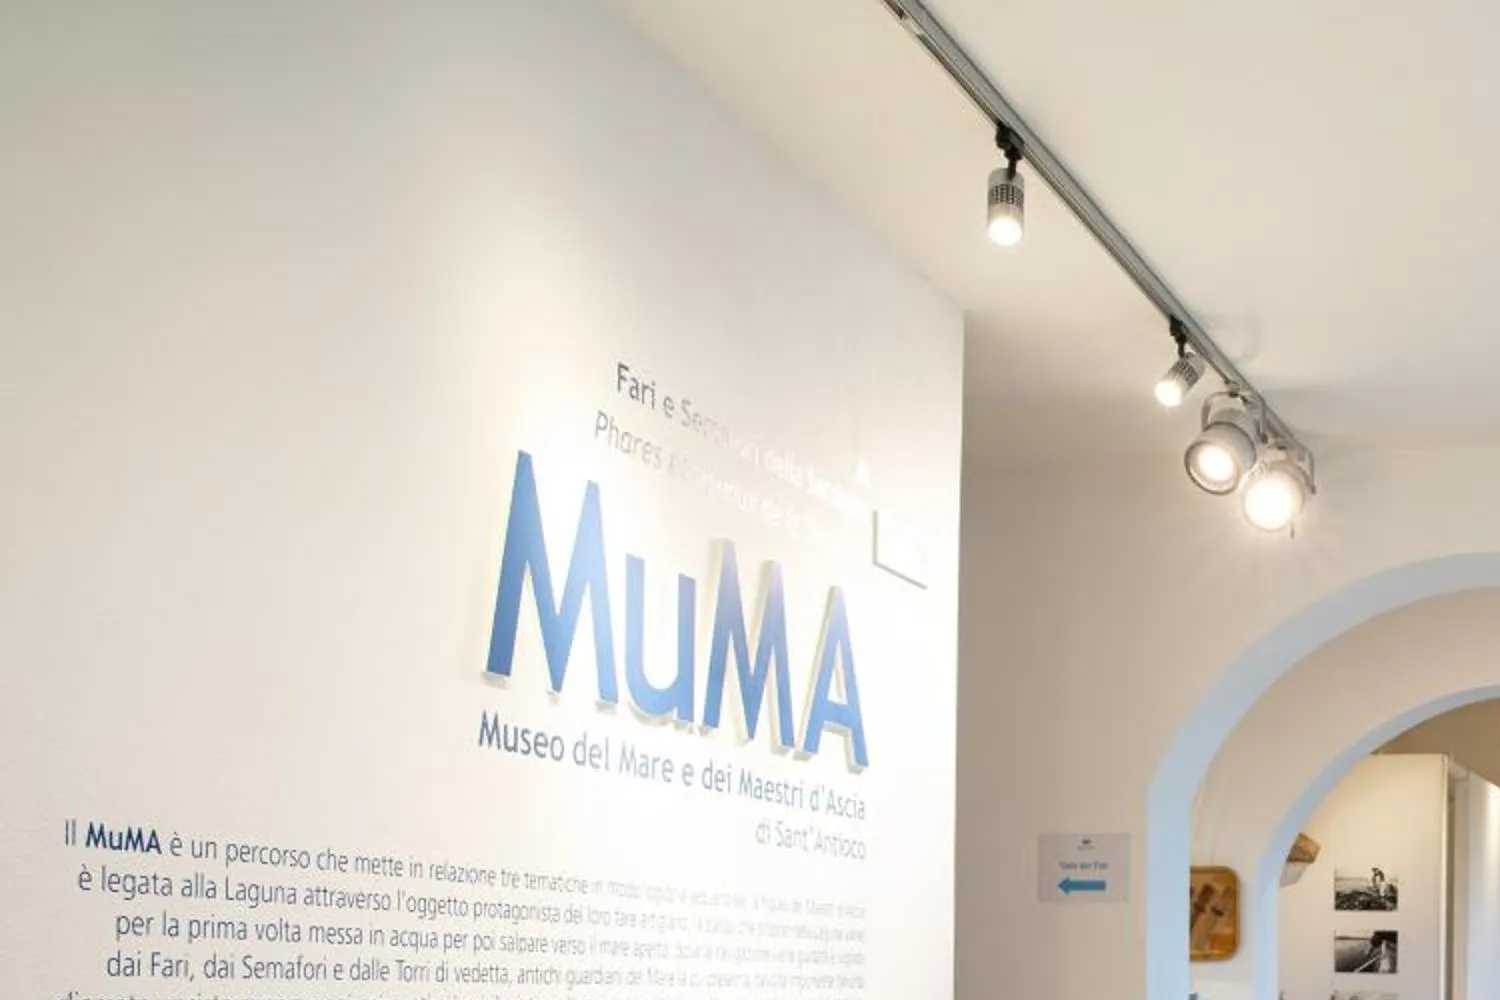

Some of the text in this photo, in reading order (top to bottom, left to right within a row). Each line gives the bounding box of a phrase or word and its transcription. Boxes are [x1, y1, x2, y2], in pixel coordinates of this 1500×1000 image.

[617, 362, 675, 419] Fari e
[595, 411, 662, 468] Phares
[485, 449, 870, 772] MuMA
[478, 709, 866, 820] Museo del Mare e dei Maestri d'Ascia
[65, 819, 77, 848] Il
[85, 821, 162, 855] MuMA
[170, 831, 183, 857] è
[191, 839, 217, 860] un
[226, 842, 311, 870] percorso
[316, 848, 349, 874] che
[355, 855, 404, 877] mette
[409, 855, 423, 879] in
[429, 860, 496, 886] relazione
[500, 868, 519, 889] tre
[756, 818, 772, 845] di
[78, 864, 92, 891] è
[101, 864, 173, 901] legata
[181, 872, 217, 899] alla
[225, 876, 297, 908] Laguna
[303, 886, 391, 911] attraverso
[397, 889, 469, 920] l'oggetto
[474, 901, 560, 925] protagonista
[115, 914, 154, 942] per
[162, 910, 179, 937] la
[188, 914, 248, 943] prima
[255, 917, 302, 943] volta
[308, 923, 362, 945] messa
[369, 921, 385, 945] in
[389, 929, 438, 954] acqua
[443, 932, 468, 954] per
[474, 933, 495, 957] poi
[499, 933, 547, 956] salpare
[551, 937, 586, 956] verso
[107, 949, 141, 977] dai
[151, 951, 195, 982] Fari,
[203, 951, 235, 979] dai
[241, 955, 327, 980] Semafori
[333, 962, 343, 980] e
[350, 957, 391, 982] dalle
[395, 958, 430, 983] Torri
[435, 959, 448, 983] di
